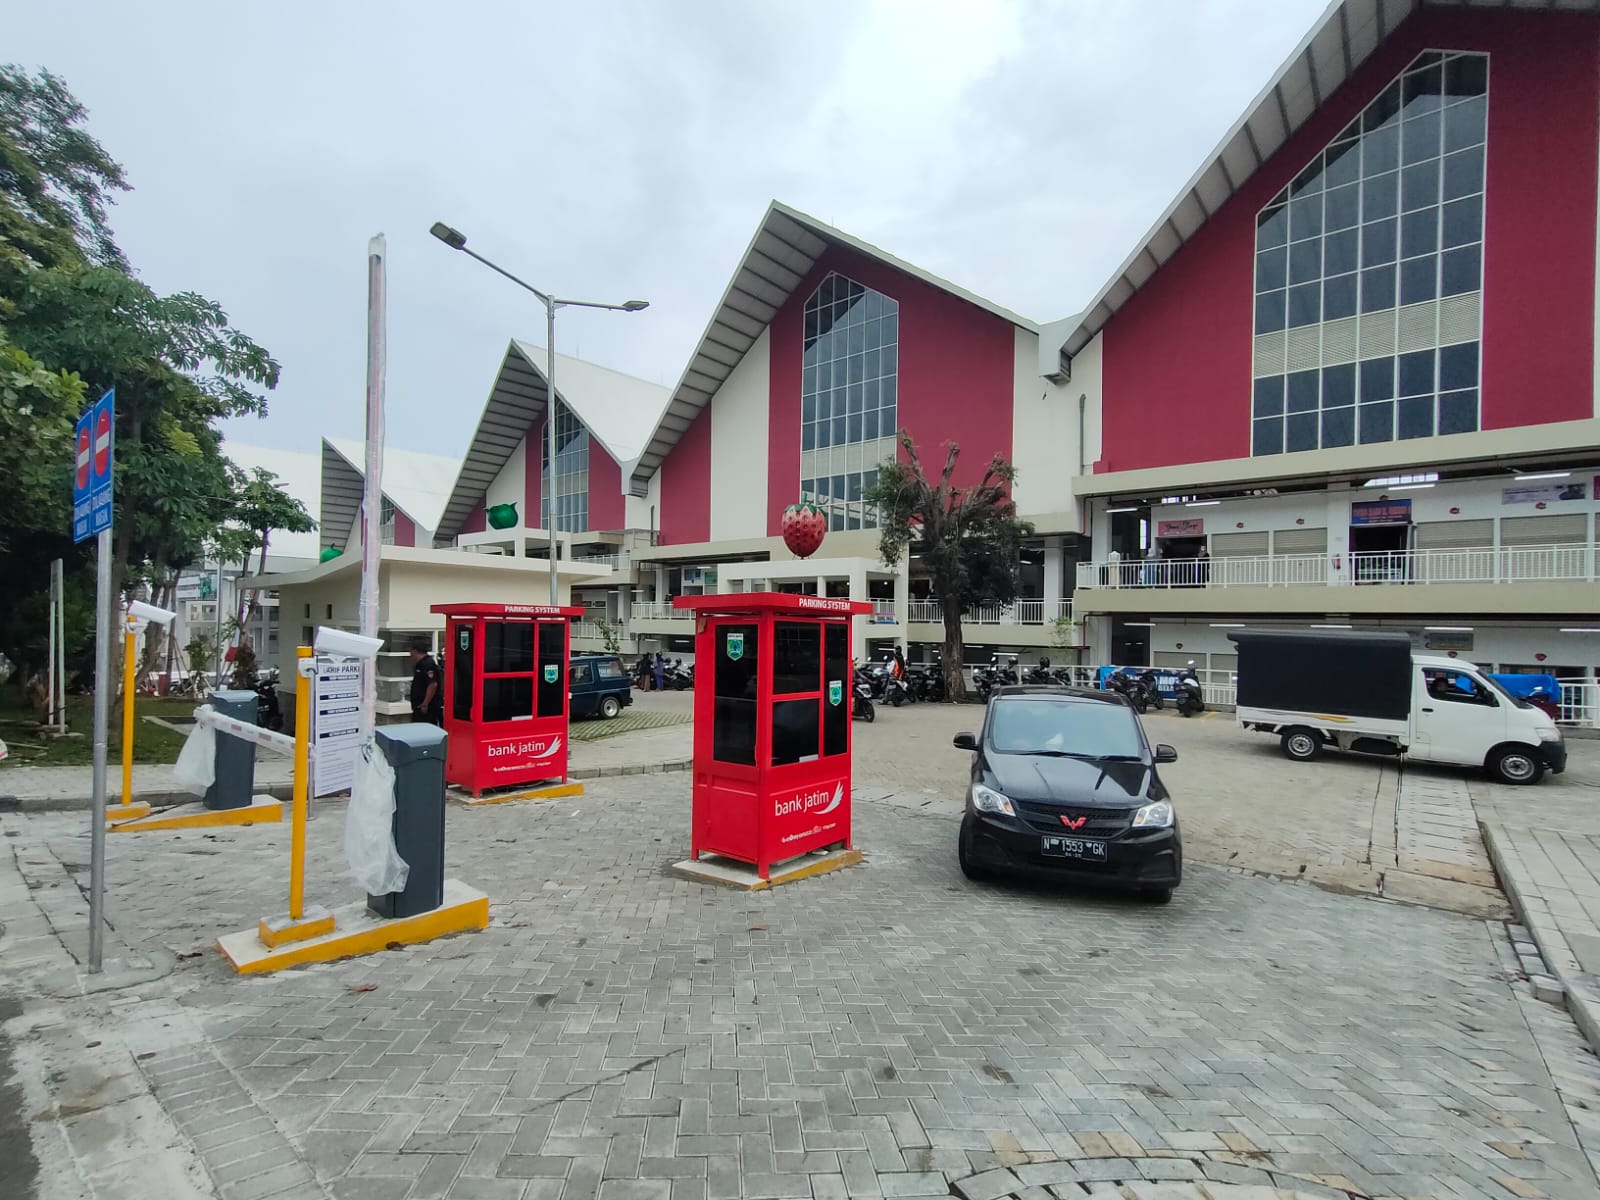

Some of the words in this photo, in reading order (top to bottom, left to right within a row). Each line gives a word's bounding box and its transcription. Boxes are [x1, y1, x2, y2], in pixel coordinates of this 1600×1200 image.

[504, 605, 534, 614] PARKING
[534, 606, 560, 615] SYSTEM
[799, 598, 827, 609] PARKING
[827, 600, 851, 611] SYSTEM
[341, 665, 360, 673] PARKI
[488, 743, 517, 757] bank
[516, 740, 545, 756] jatim
[775, 794, 802, 817] bank
[803, 790, 830, 814] jatim
[1043, 837, 1050, 850] N
[1061, 839, 1084, 853] 1553
[1092, 843, 1105, 856] GK
